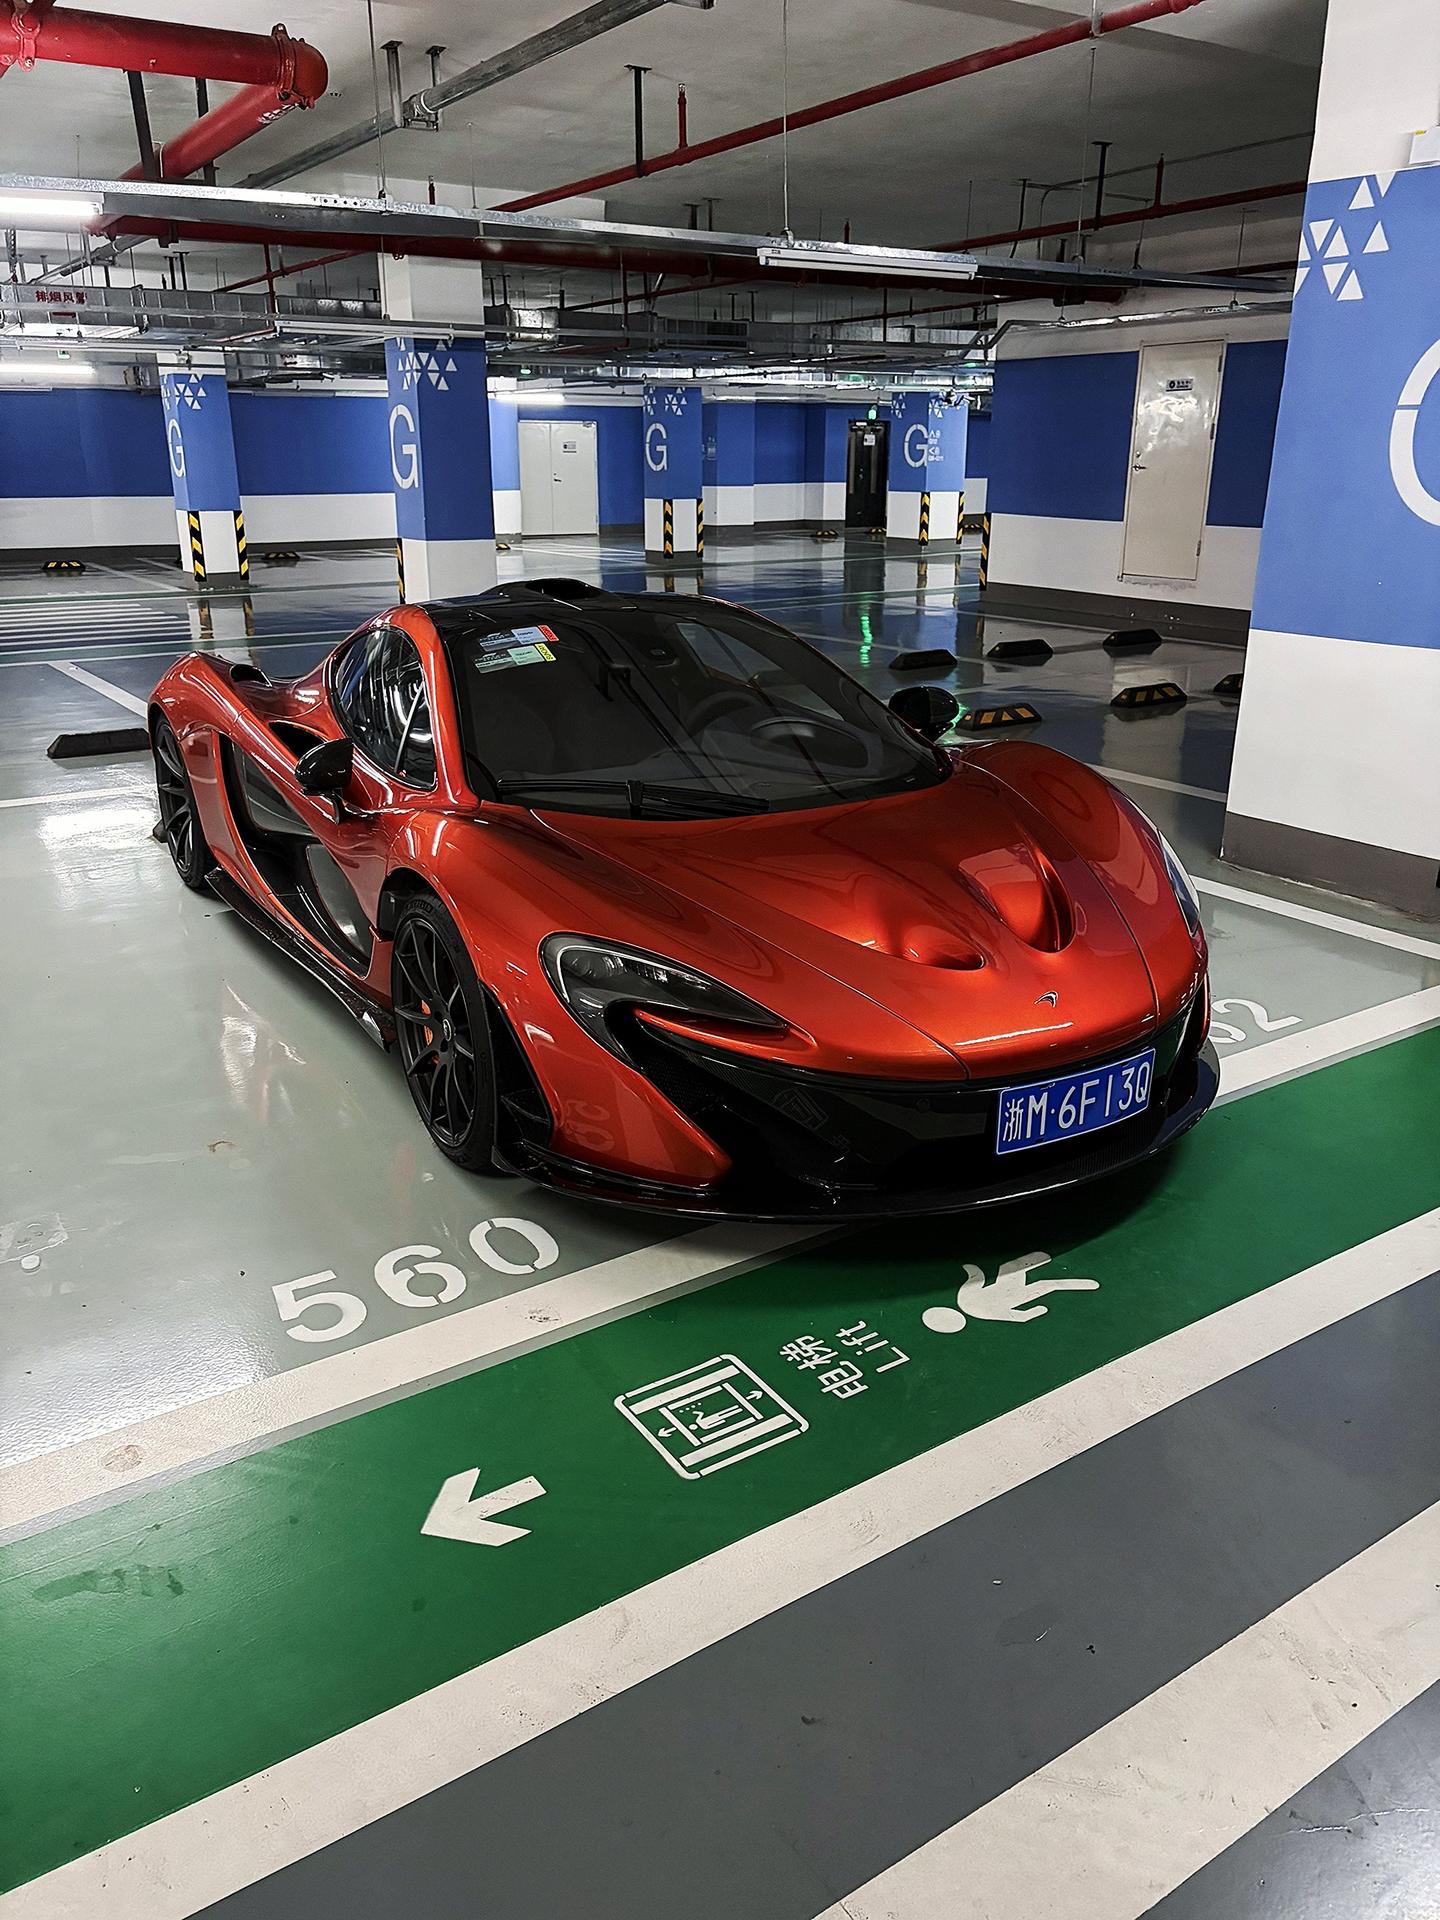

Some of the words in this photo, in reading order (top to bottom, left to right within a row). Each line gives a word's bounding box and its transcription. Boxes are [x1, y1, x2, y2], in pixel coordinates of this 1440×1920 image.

[167, 418, 186, 478] G
[388, 404, 419, 490] G
[645, 422, 668, 472] G
[904, 423, 929, 468] G
[271, 1216, 560, 1343] 560
[779, 1335, 869, 1400] 电梯
[835, 1320, 911, 1373] Lift
